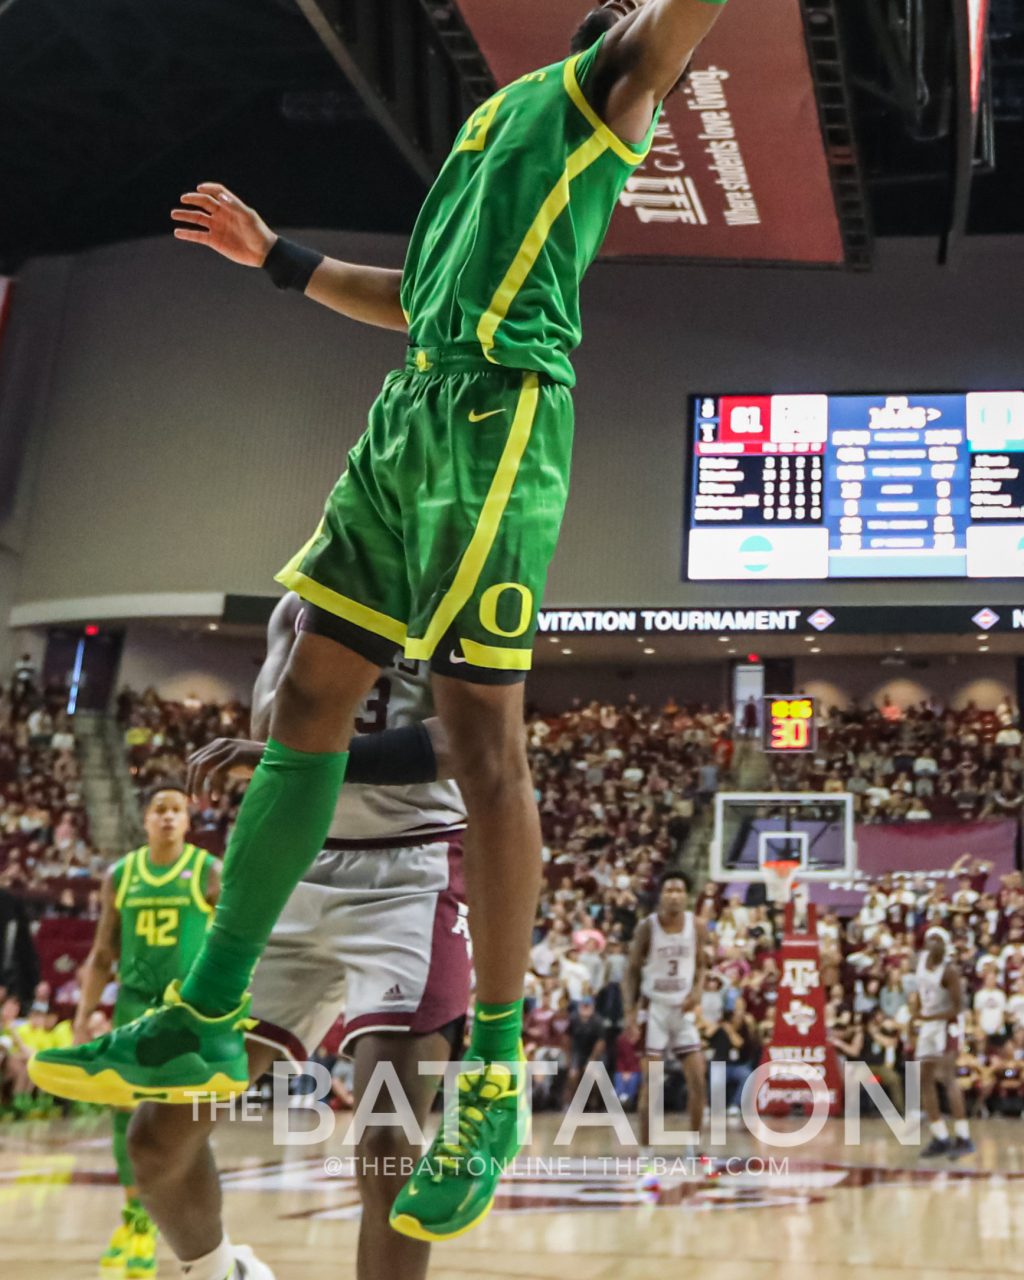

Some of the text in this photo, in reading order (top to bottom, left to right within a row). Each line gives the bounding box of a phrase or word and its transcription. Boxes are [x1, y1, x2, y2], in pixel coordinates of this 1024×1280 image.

[697, 111, 735, 140] love
[479, 582, 533, 638] O
[536, 610, 801, 631] VITATION TOURNAMENT
[771, 718, 809, 748] 30
[135, 908, 179, 946] 42
[667, 960, 679, 976] 3
